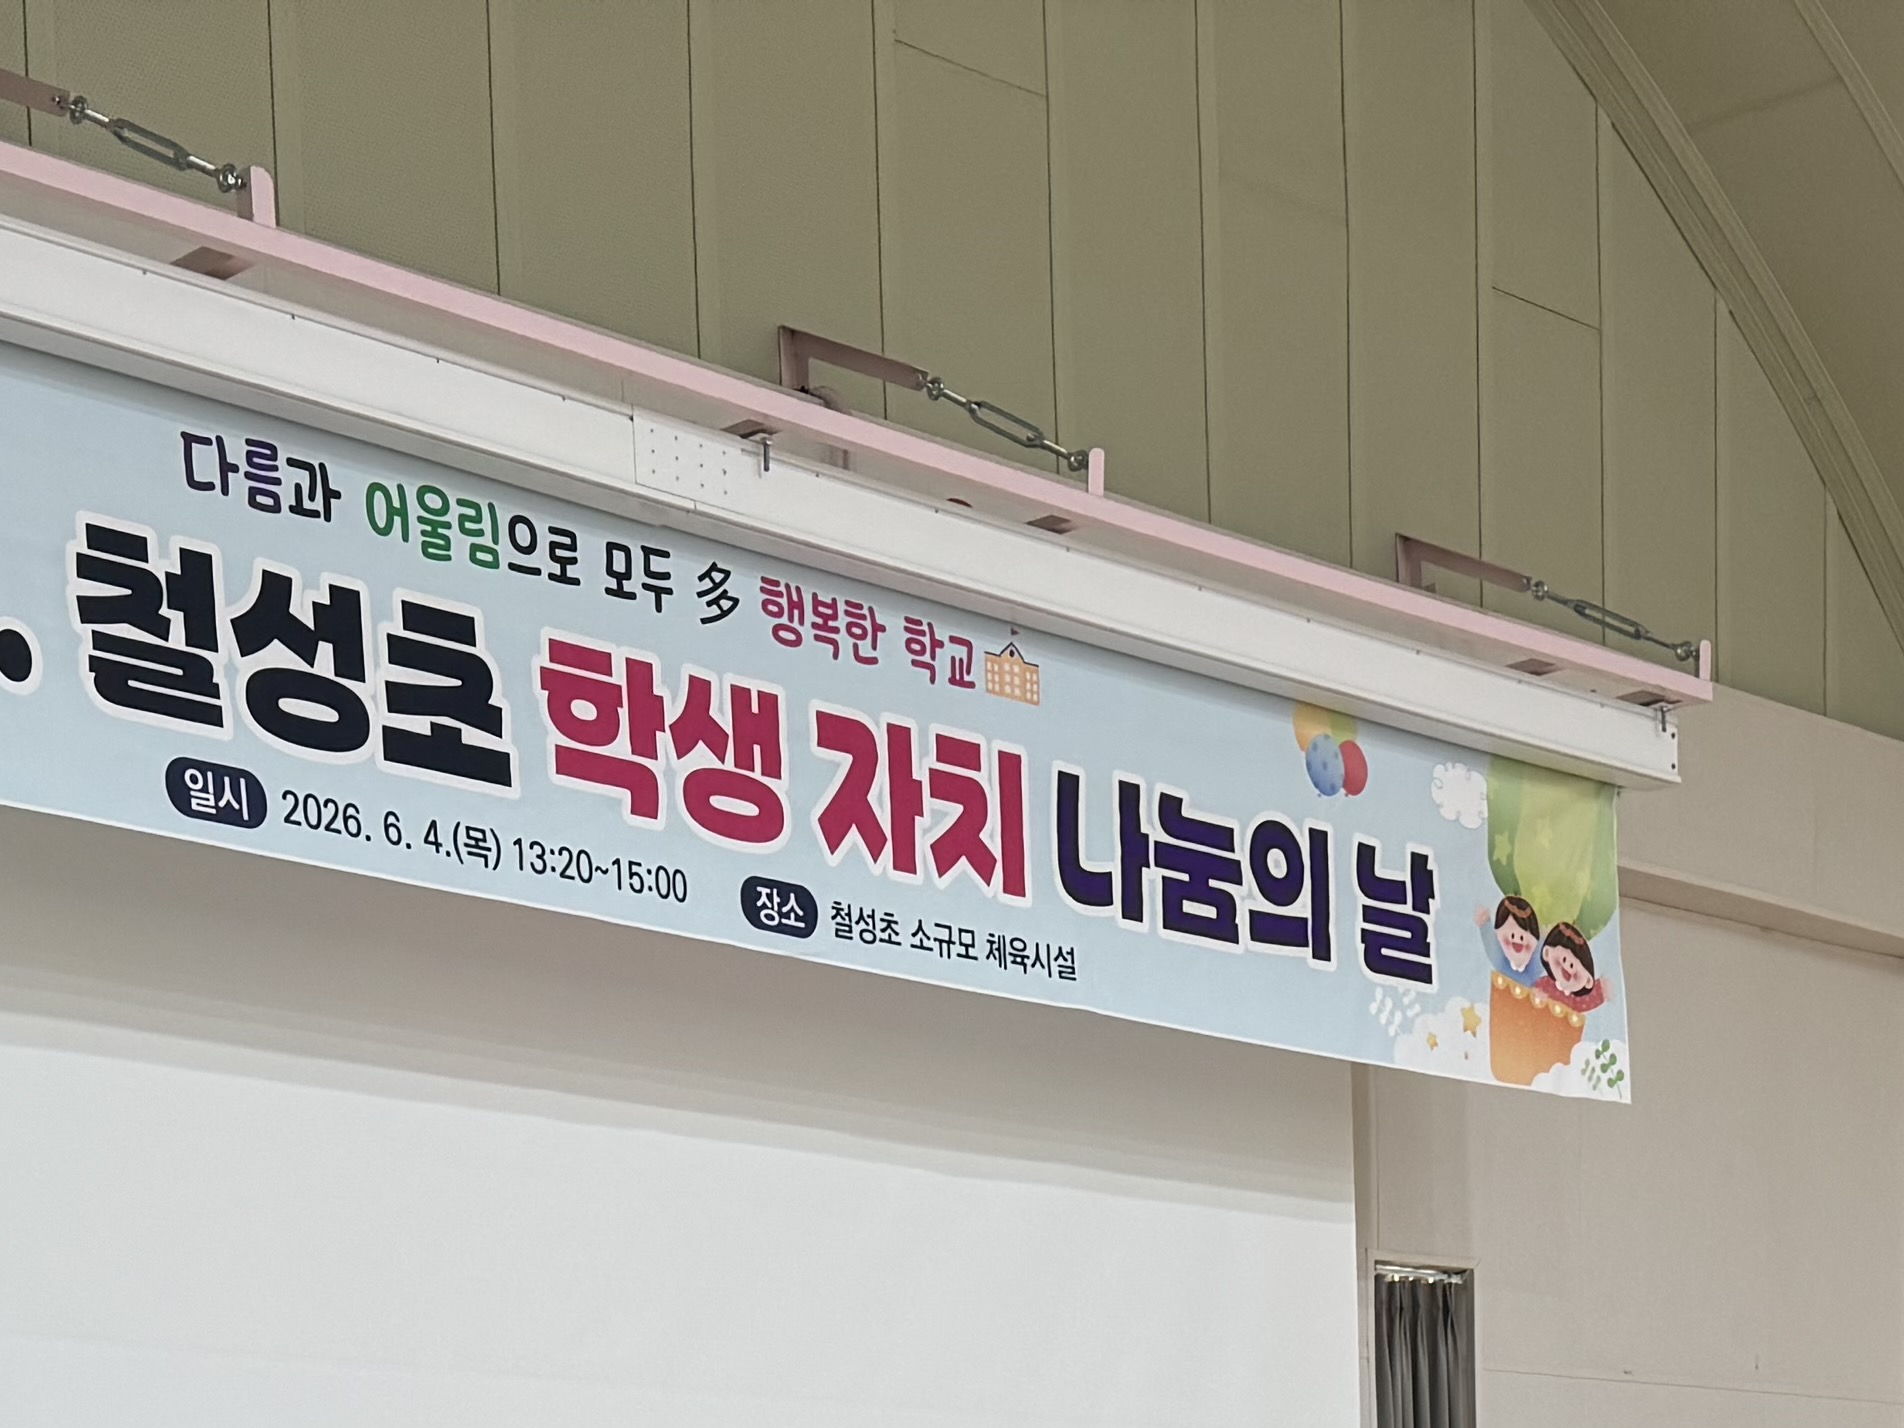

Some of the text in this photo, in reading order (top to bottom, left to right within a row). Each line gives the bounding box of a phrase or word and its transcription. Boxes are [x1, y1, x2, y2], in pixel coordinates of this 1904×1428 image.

[181, 430, 977, 692] 다름과 어울림으로 모두 多 행복한 학교
[75, 521, 515, 789] 철성초
[539, 638, 786, 845] 학생
[815, 711, 1026, 899] 자치
[1056, 770, 1332, 961] 나눔의
[1355, 841, 1435, 985] 날
[183, 769, 250, 821] 일시
[280, 789, 689, 904] 2026. 6. 4.(목) 13:20~15:00
[756, 886, 807, 931] 장소
[829, 899, 1079, 983] 철성초 소규모 체육시설
